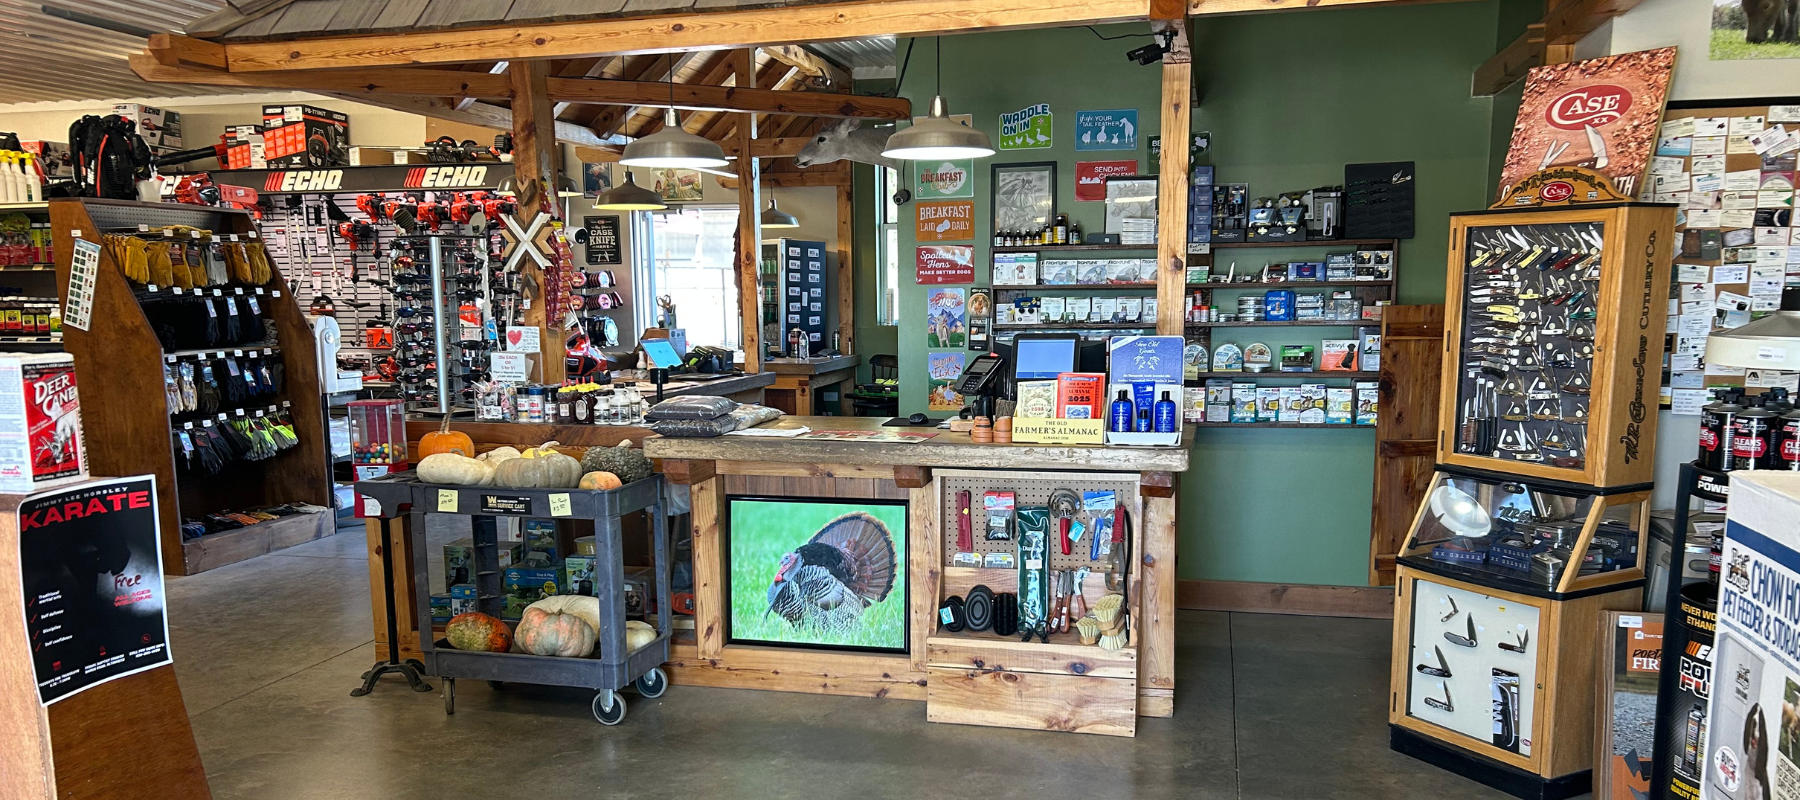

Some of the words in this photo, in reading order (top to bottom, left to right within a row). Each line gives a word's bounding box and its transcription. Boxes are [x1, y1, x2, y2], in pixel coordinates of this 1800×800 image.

[144, 106, 160, 115] ECHO
[1002, 104, 1048, 124] WADDLE
[1003, 125, 1016, 135] ON
[1020, 120, 1029, 131] IN
[281, 170, 343, 191] ECHO
[422, 166, 488, 188] ECHO
[921, 172, 963, 183] BREAKFAST
[920, 206, 971, 220] BREAKFAST
[920, 222, 935, 232] LAID
[952, 221, 970, 230] DAILY
[590, 236, 616, 246] KNIFE
[920, 250, 952, 262] Spoiled
[1058, 427, 1098, 436] ALMANAC
[1734, 438, 1761, 447] CLEANS
[35, 498, 62, 508] JIMMY
[84, 486, 128, 498] HORSLEY
[22, 490, 150, 532] KARATE
[1502, 559, 1526, 569] TESTED
[114, 574, 142, 590] Free
[1752, 560, 1785, 614] CHOW
[1681, 602, 1701, 616] NEVER
[1722, 587, 1738, 619] PET
[1764, 614, 1772, 641] &
